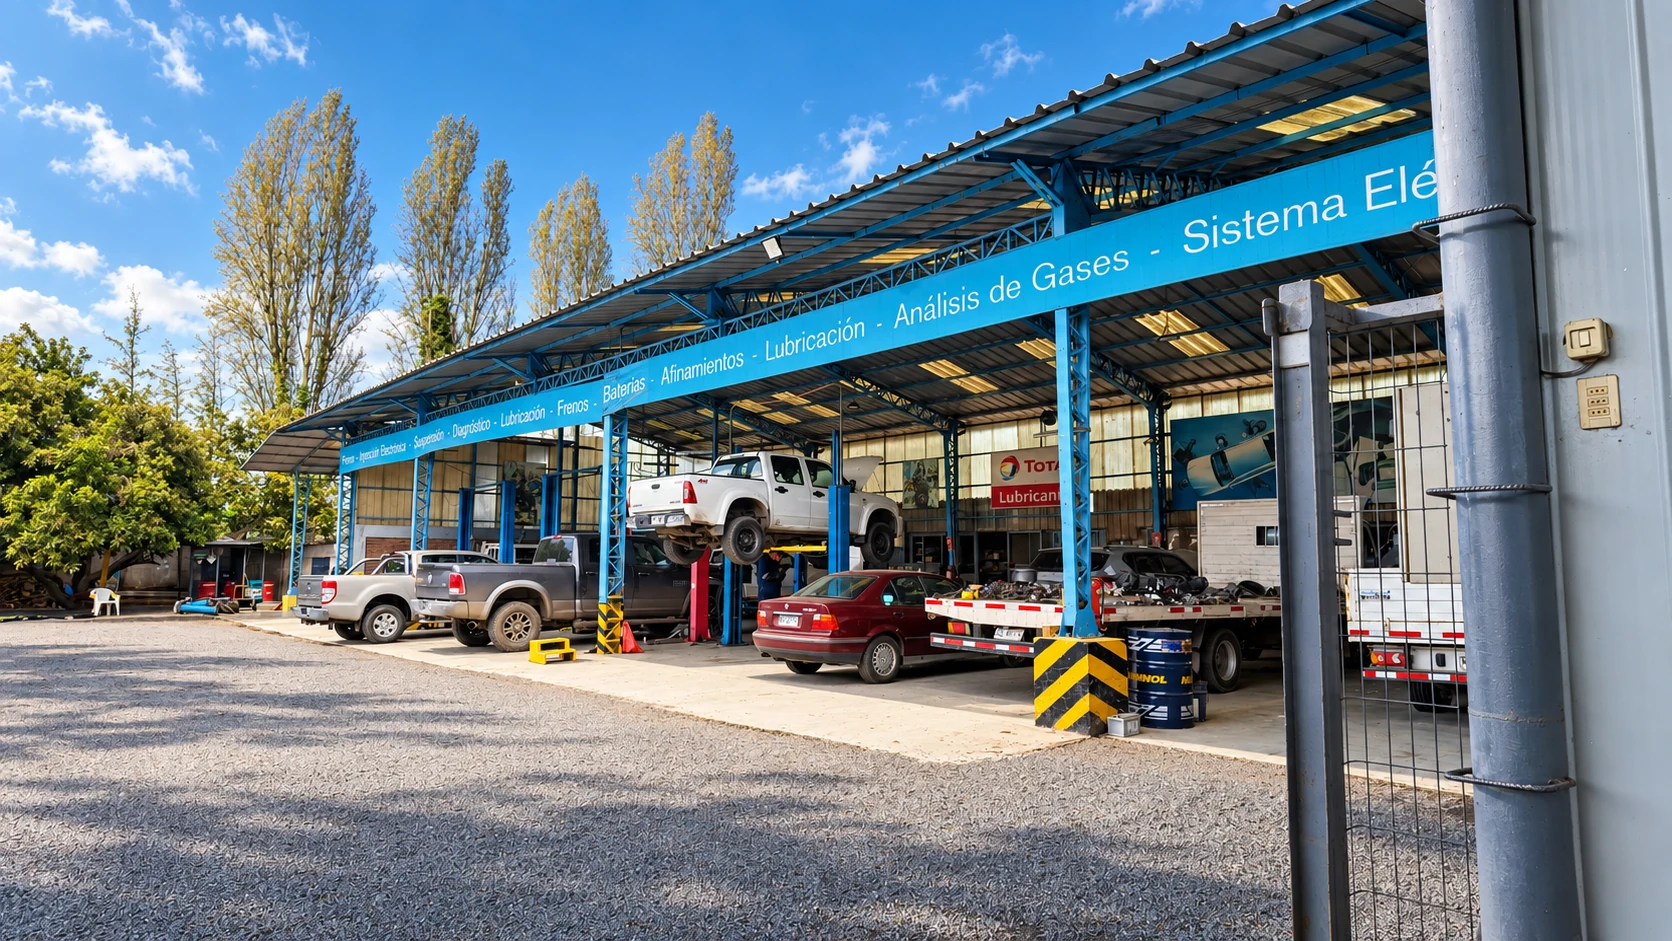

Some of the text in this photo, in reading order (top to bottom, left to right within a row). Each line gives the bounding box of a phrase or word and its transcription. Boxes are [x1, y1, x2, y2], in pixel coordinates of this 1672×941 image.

[500, 404, 545, 427] Lubricación
[557, 398, 589, 416] Frenos
[661, 352, 744, 386] Afinamientos
[766, 316, 865, 361] Lubricación
[894, 286, 980, 329] Análisis
[989, 275, 1021, 304] de
[1032, 249, 1130, 292] Gases
[1183, 193, 1348, 254] Sistema
[1365, 158, 1438, 212] Elé
[1000, 489, 1060, 503] Lubrican
